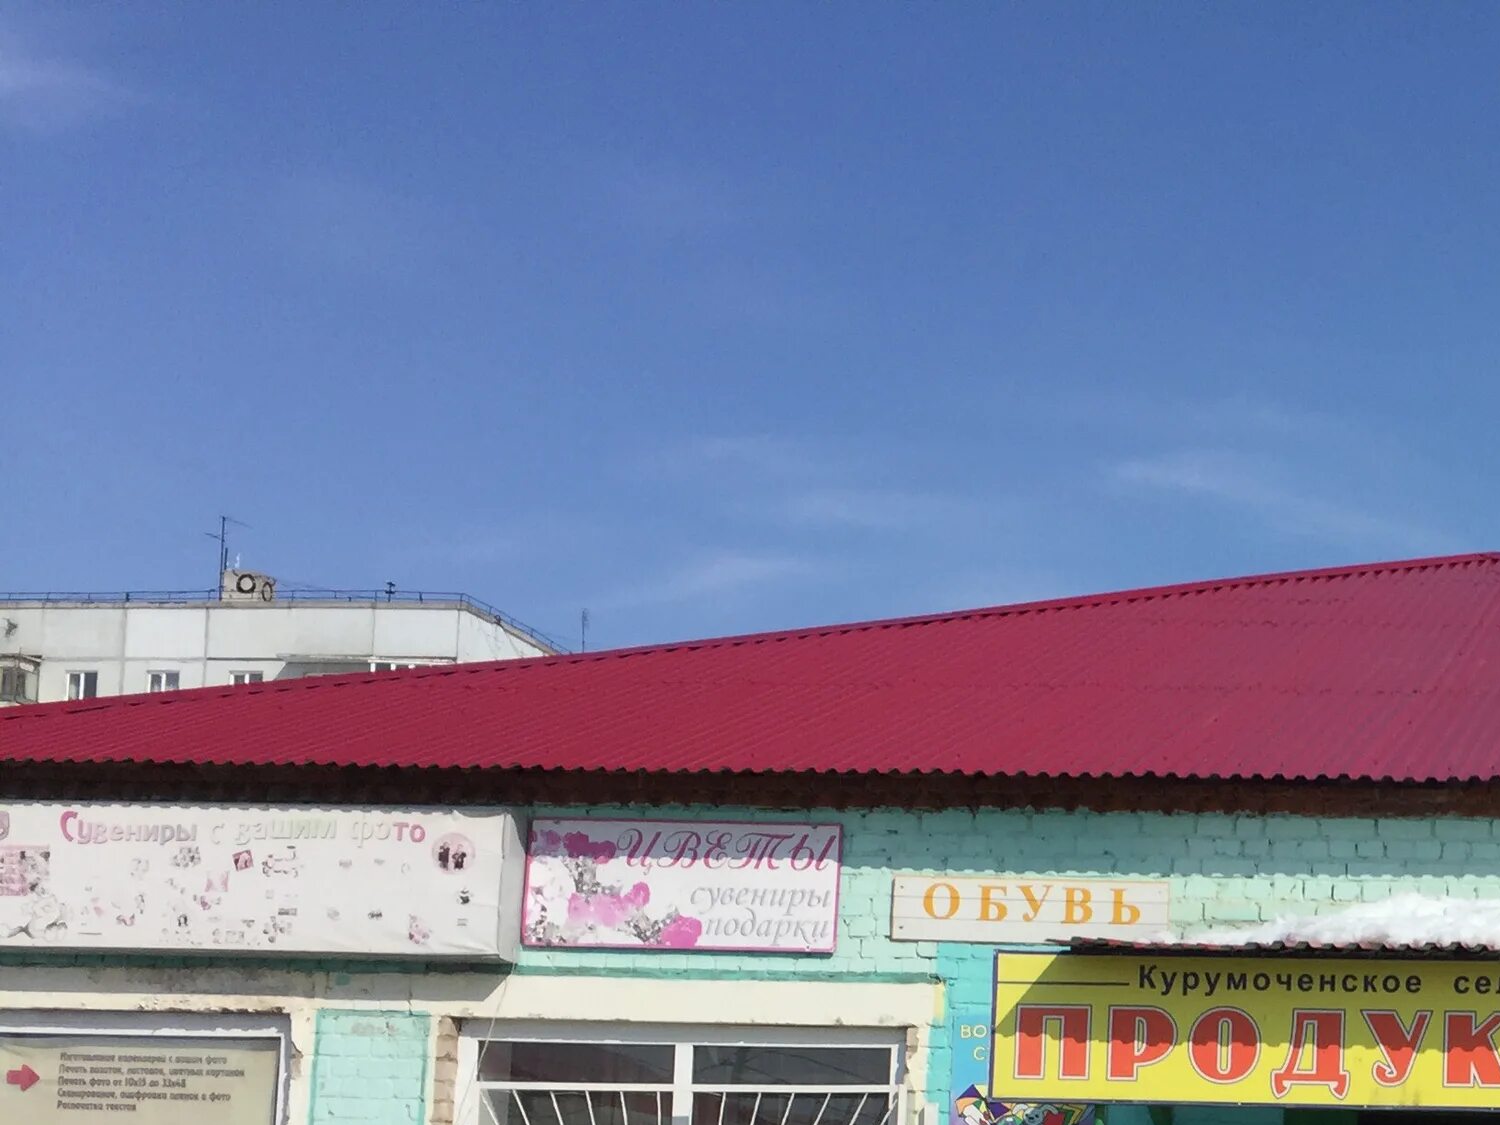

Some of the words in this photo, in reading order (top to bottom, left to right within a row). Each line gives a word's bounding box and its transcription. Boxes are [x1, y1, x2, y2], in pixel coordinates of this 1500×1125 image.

[60, 810, 198, 846] Сувениры
[234, 818, 338, 846] вашим
[350, 814, 427, 848] фото
[616, 828, 838, 872] ЦВЕТЫ
[690, 884, 831, 916] сувениры
[922, 882, 1141, 925] ОБУВЬ
[704, 907, 831, 946] подарки
[1138, 963, 1423, 996] Курумоченское
[57, 1076, 87, 1087] Печать
[88, 1078, 111, 1088] фото
